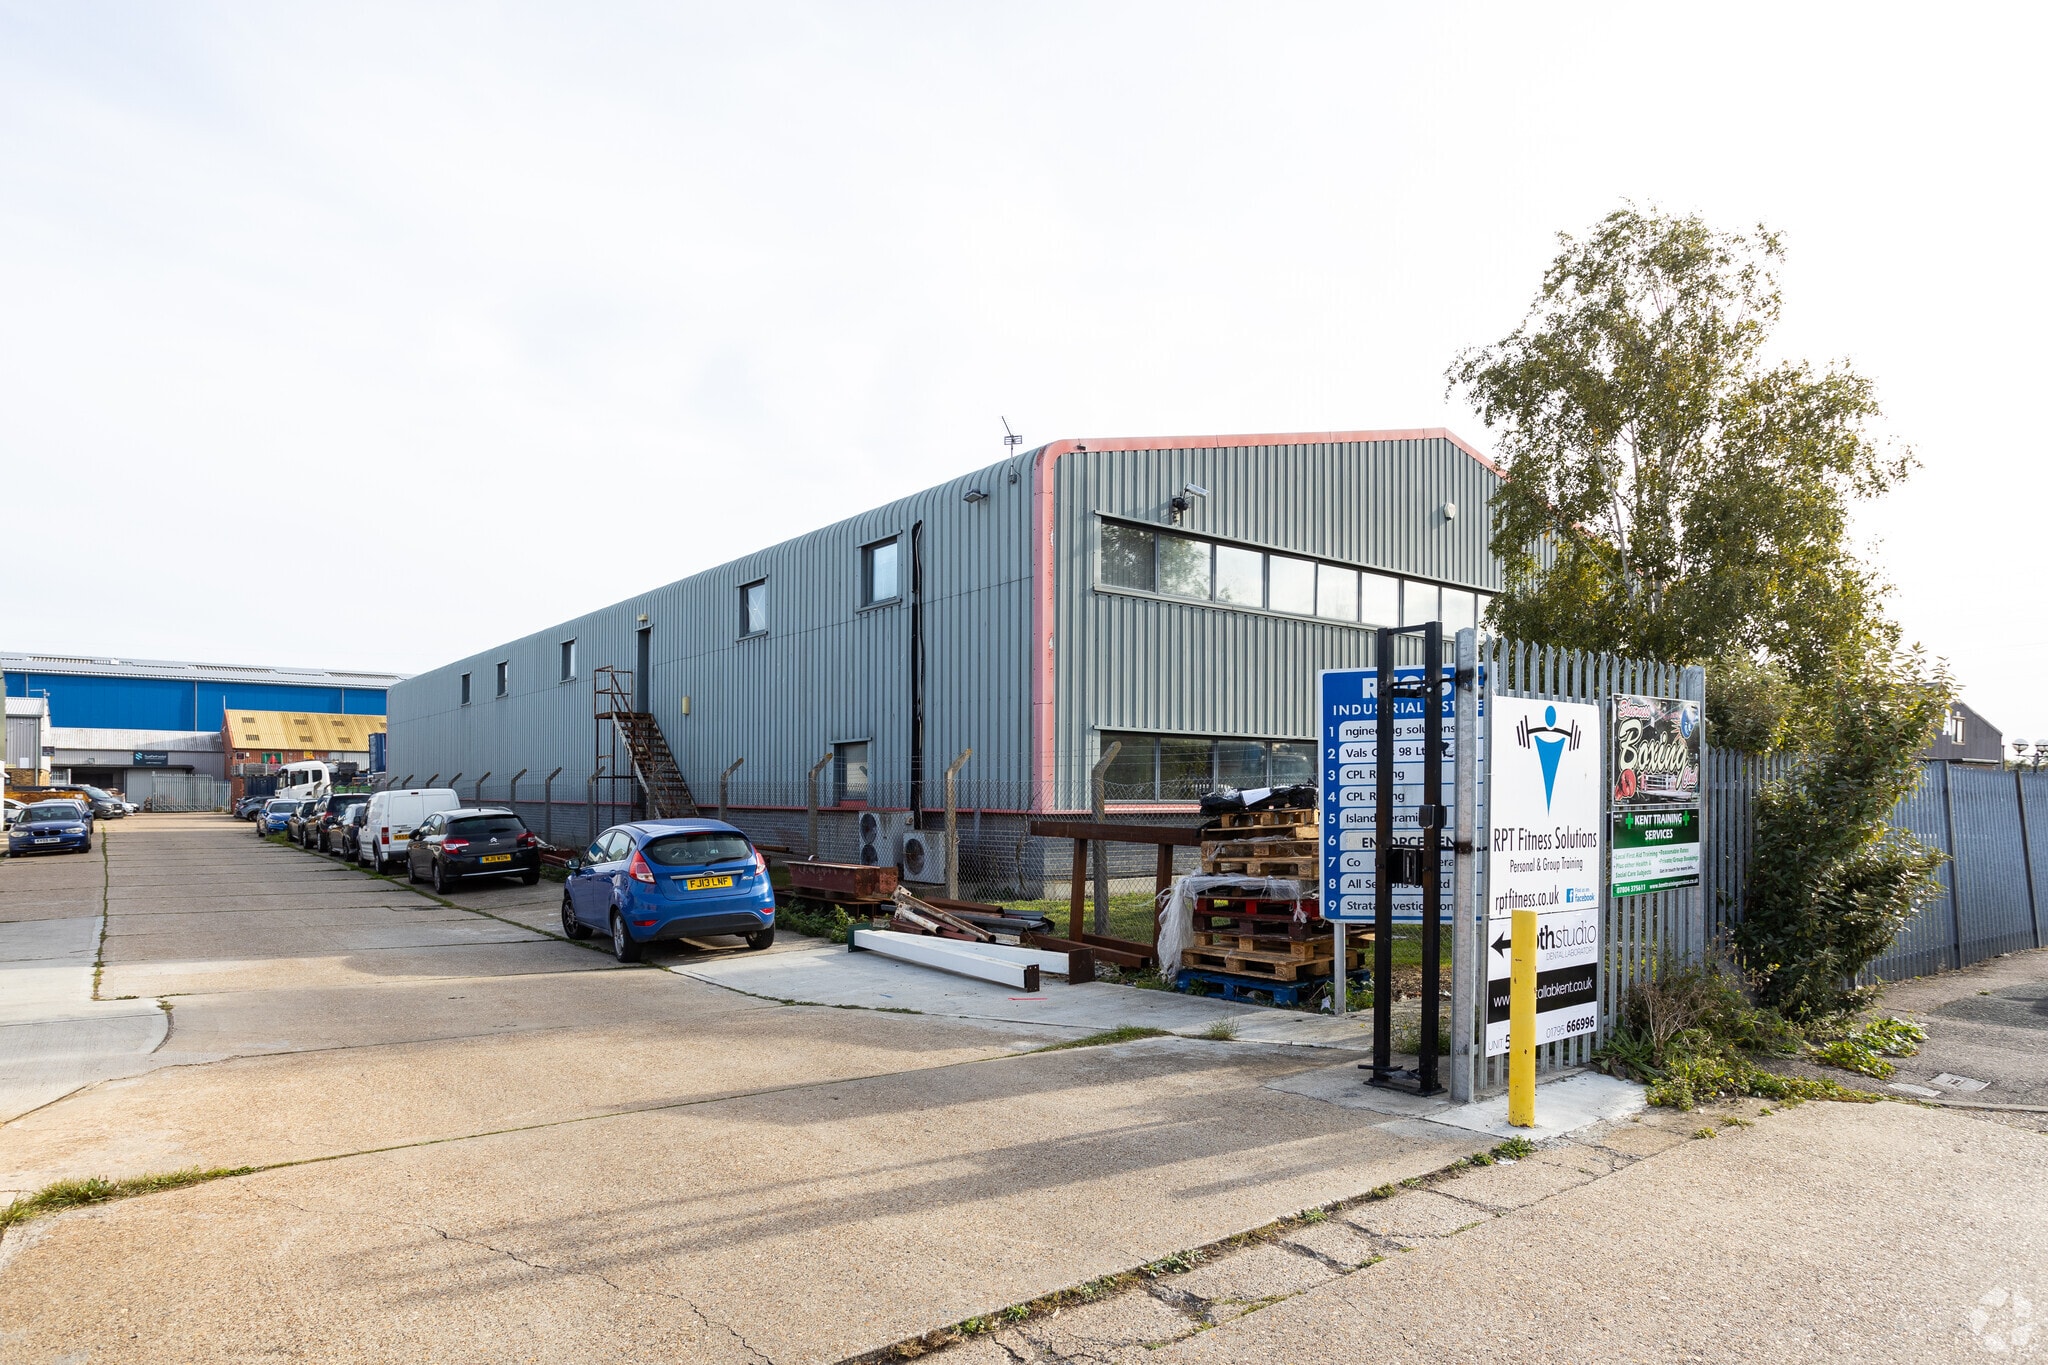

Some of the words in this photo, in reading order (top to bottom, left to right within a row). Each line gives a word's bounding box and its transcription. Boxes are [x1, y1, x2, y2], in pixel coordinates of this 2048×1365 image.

[1329, 726, 1334, 737] 1
[1328, 748, 1335, 759] 2
[1346, 748, 1367, 757] Vals
[1399, 747, 1411, 756] 98
[1619, 717, 1687, 789] Boxing
[1328, 770, 1336, 781] 3
[1346, 770, 1365, 779] CPL
[1328, 791, 1336, 802] 4
[1346, 792, 1365, 801] CPL
[1328, 813, 1336, 824] 5
[1634, 814, 1652, 826] KENT
[1654, 813, 1682, 825] TRAINING
[1494, 828, 1515, 852] RPT
[1519, 827, 1552, 851] Fitness
[1555, 825, 1597, 849] Solutions
[1645, 829, 1673, 840] SERVICES
[1328, 835, 1336, 846] 6
[1328, 857, 1336, 868] 7
[1510, 857, 1535, 873] Personal
[1537, 858, 1541, 871] &
[1543, 857, 1560, 873] Group
[1561, 856, 1583, 871] Training
[690, 879, 710, 888] FJ13
[712, 877, 728, 886] LNF
[1328, 879, 1337, 889] 8
[1348, 880, 1361, 889] All
[1496, 884, 1559, 915] rptfitness.co.uk
[1575, 893, 1595, 902] facebook
[1328, 901, 1337, 911] 9
[1546, 953, 1564, 961] DENTAL
[1565, 947, 1595, 960] LABORATORY
[1546, 1025, 1565, 1039] 01795
[1566, 1015, 1595, 1033] 666996
[1488, 1038, 1503, 1051] UNIT
